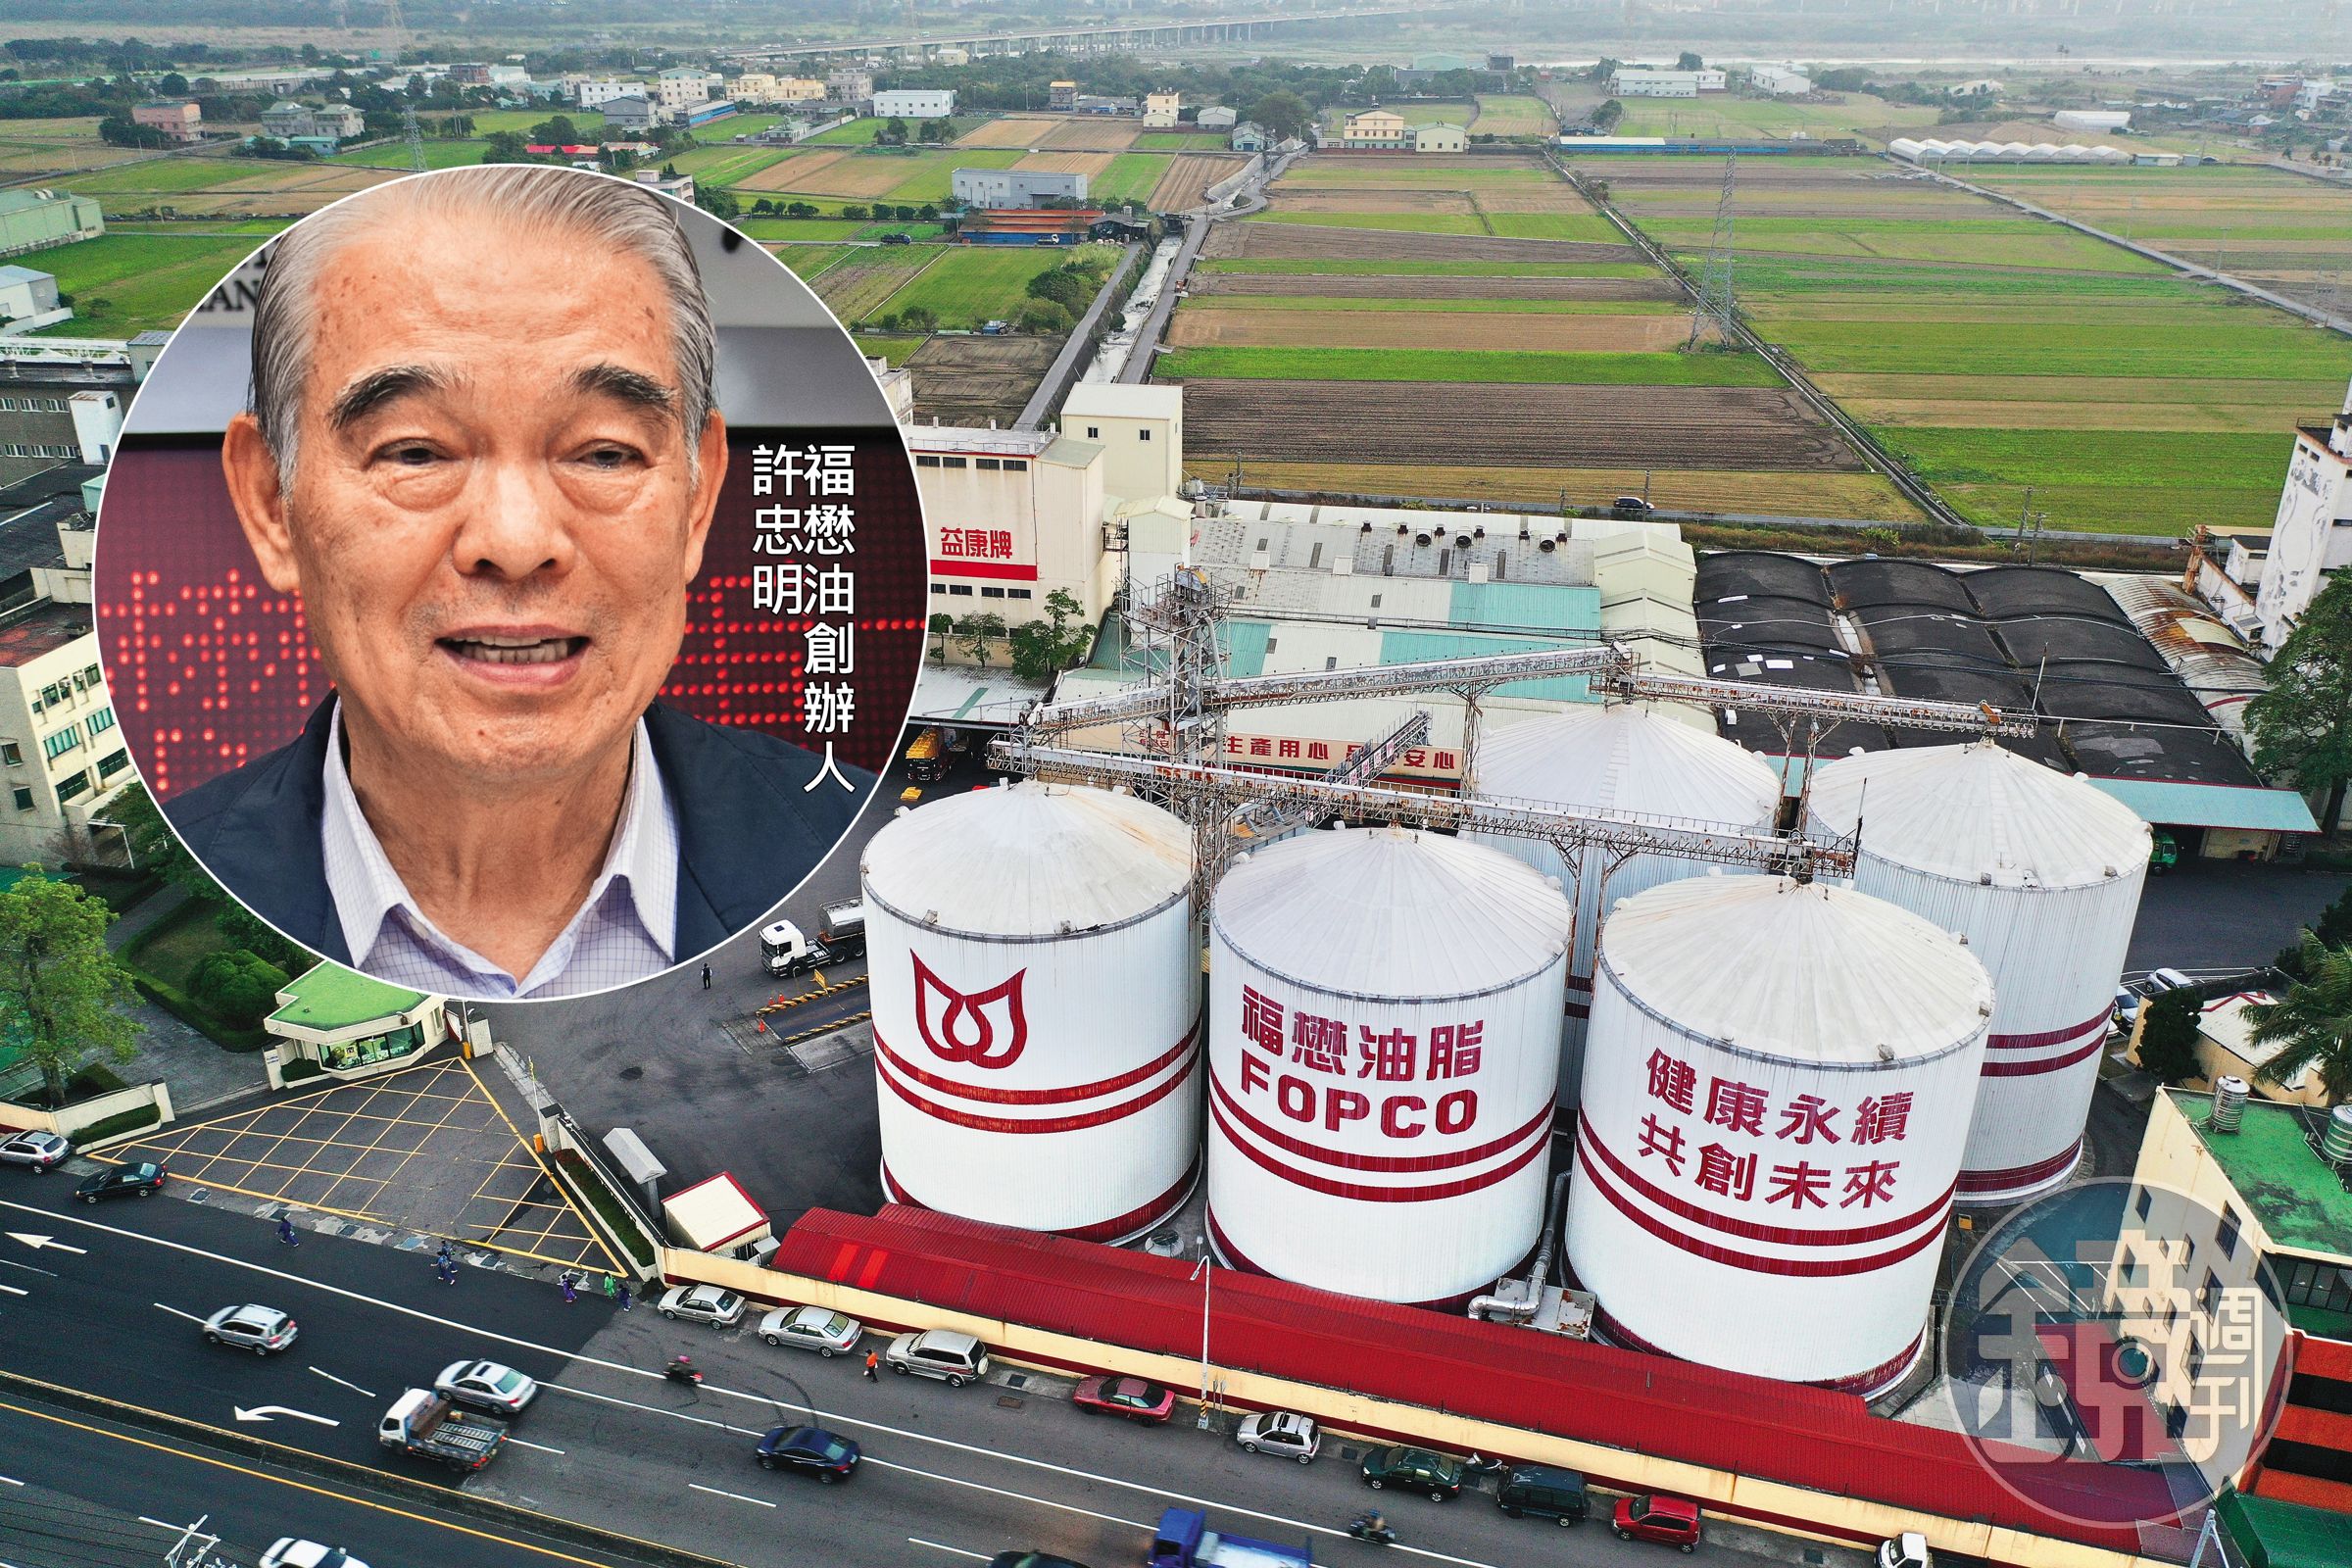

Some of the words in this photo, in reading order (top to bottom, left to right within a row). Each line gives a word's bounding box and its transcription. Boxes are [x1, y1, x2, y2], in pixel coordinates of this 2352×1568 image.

[941, 526, 1012, 559] 益康牌
[1223, 735, 1329, 760] 生產用心
[1346, 744, 1455, 770] 安心
[1242, 983, 1484, 1082] 福懋油脂
[1241, 1048, 1478, 1139] FOPCO
[1646, 1047, 1914, 1146] 健康永續
[1638, 1112, 1900, 1210] 共創未來
